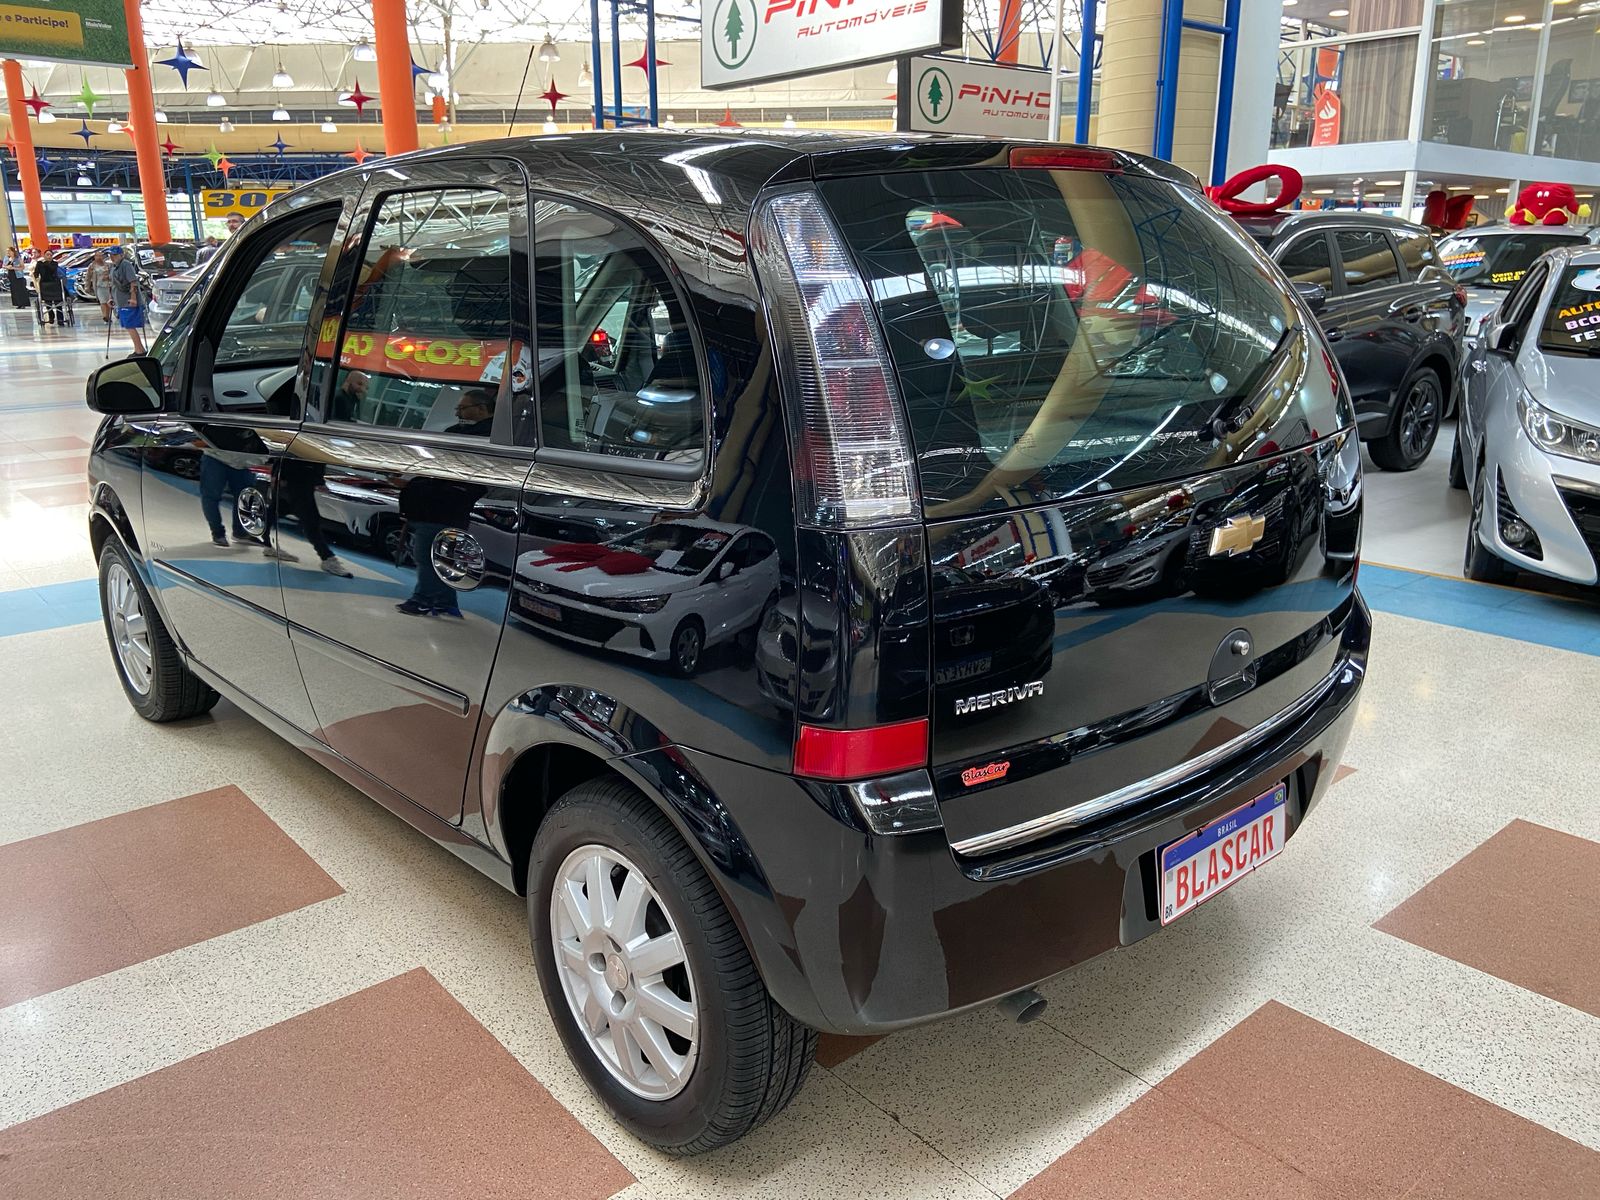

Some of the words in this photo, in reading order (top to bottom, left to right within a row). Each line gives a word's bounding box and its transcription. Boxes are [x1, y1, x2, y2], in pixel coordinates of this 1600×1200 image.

[15, 14, 69, 28] Participe!
[207, 192, 292, 208] 30
[955, 680, 1044, 715] MERIVA
[962, 762, 1009, 783] BlasCar
[1217, 819, 1238, 837] BRASIL
[1176, 814, 1275, 909] BLASCAR
[1165, 903, 1173, 919] BR
